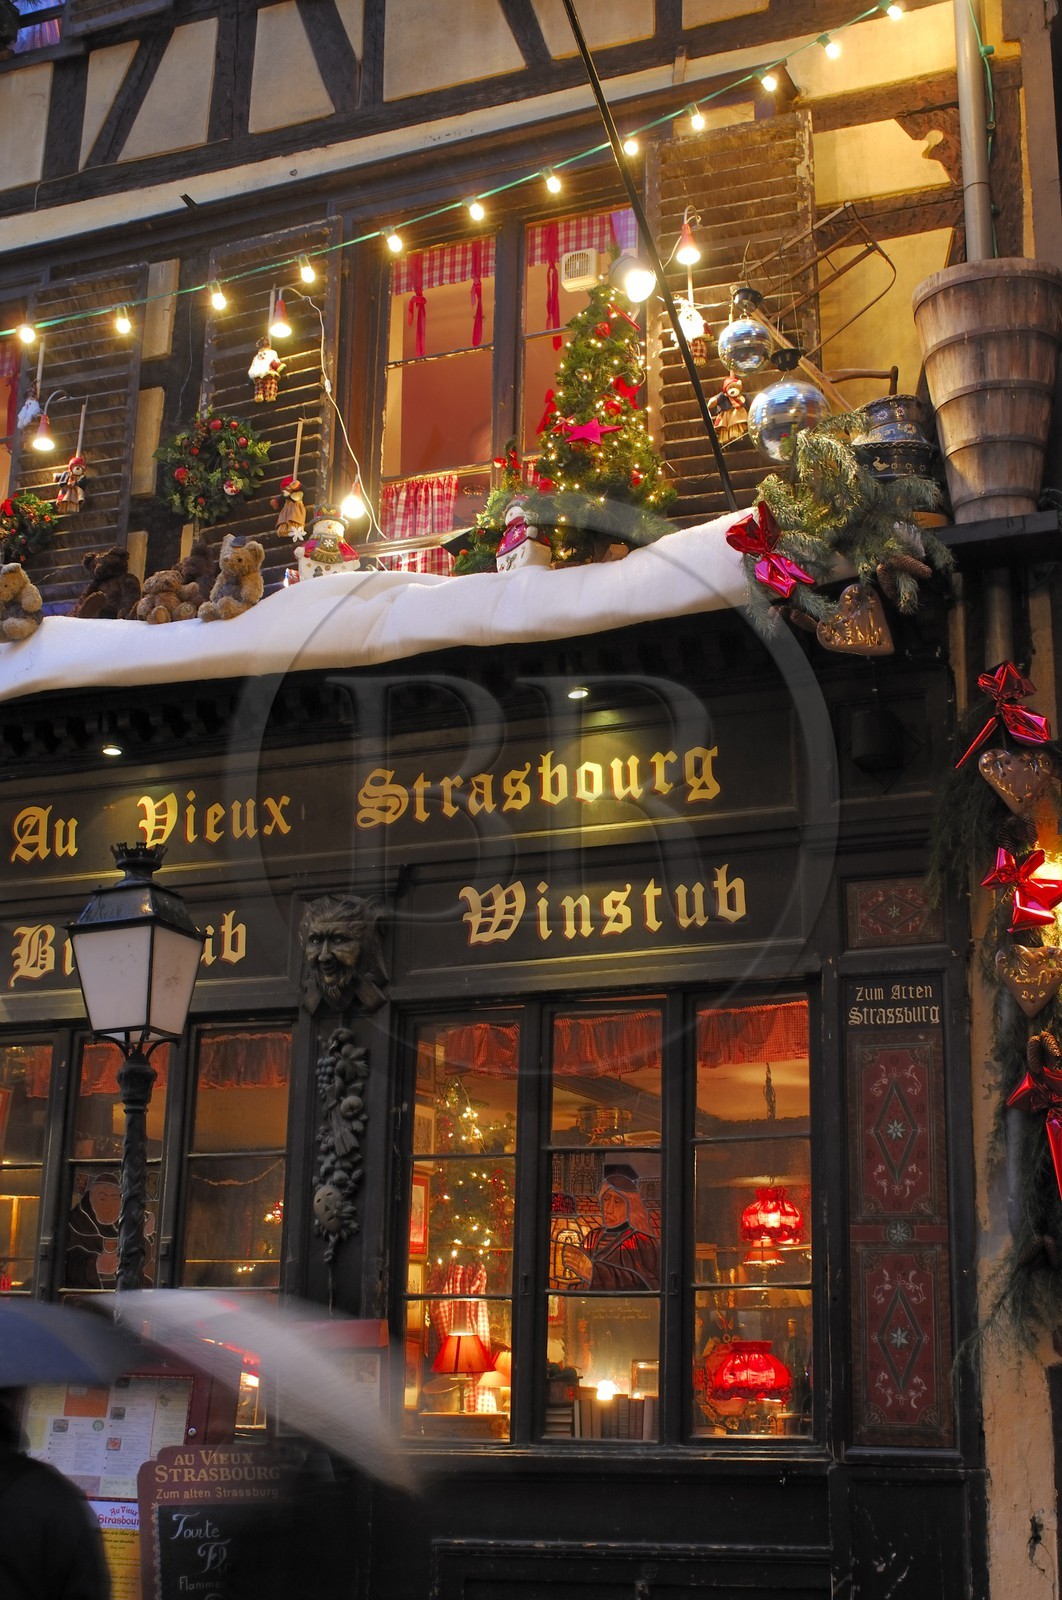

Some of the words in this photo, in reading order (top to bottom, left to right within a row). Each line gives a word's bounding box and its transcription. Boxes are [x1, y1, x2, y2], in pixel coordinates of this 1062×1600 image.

[10, 804, 79, 864] Au
[136, 790, 292, 849] Vieux
[355, 745, 721, 829] Strasbourg
[458, 863, 747, 946] Winstub
[855, 986, 884, 1001] Zum
[891, 984, 933, 1000] Alten
[848, 1005, 940, 1025] Strassburg
[174, 1454, 195, 1466] AU
[155, 1465, 279, 1483] STRASBOURG
[156, 1489, 179, 1499] Zum
[184, 1487, 211, 1499] alten
[215, 1486, 279, 1499] Strassburg
[97, 1514, 140, 1526] Strasbour
[110, 1508, 120, 1516] Au
[169, 1512, 221, 1540] Tarte
